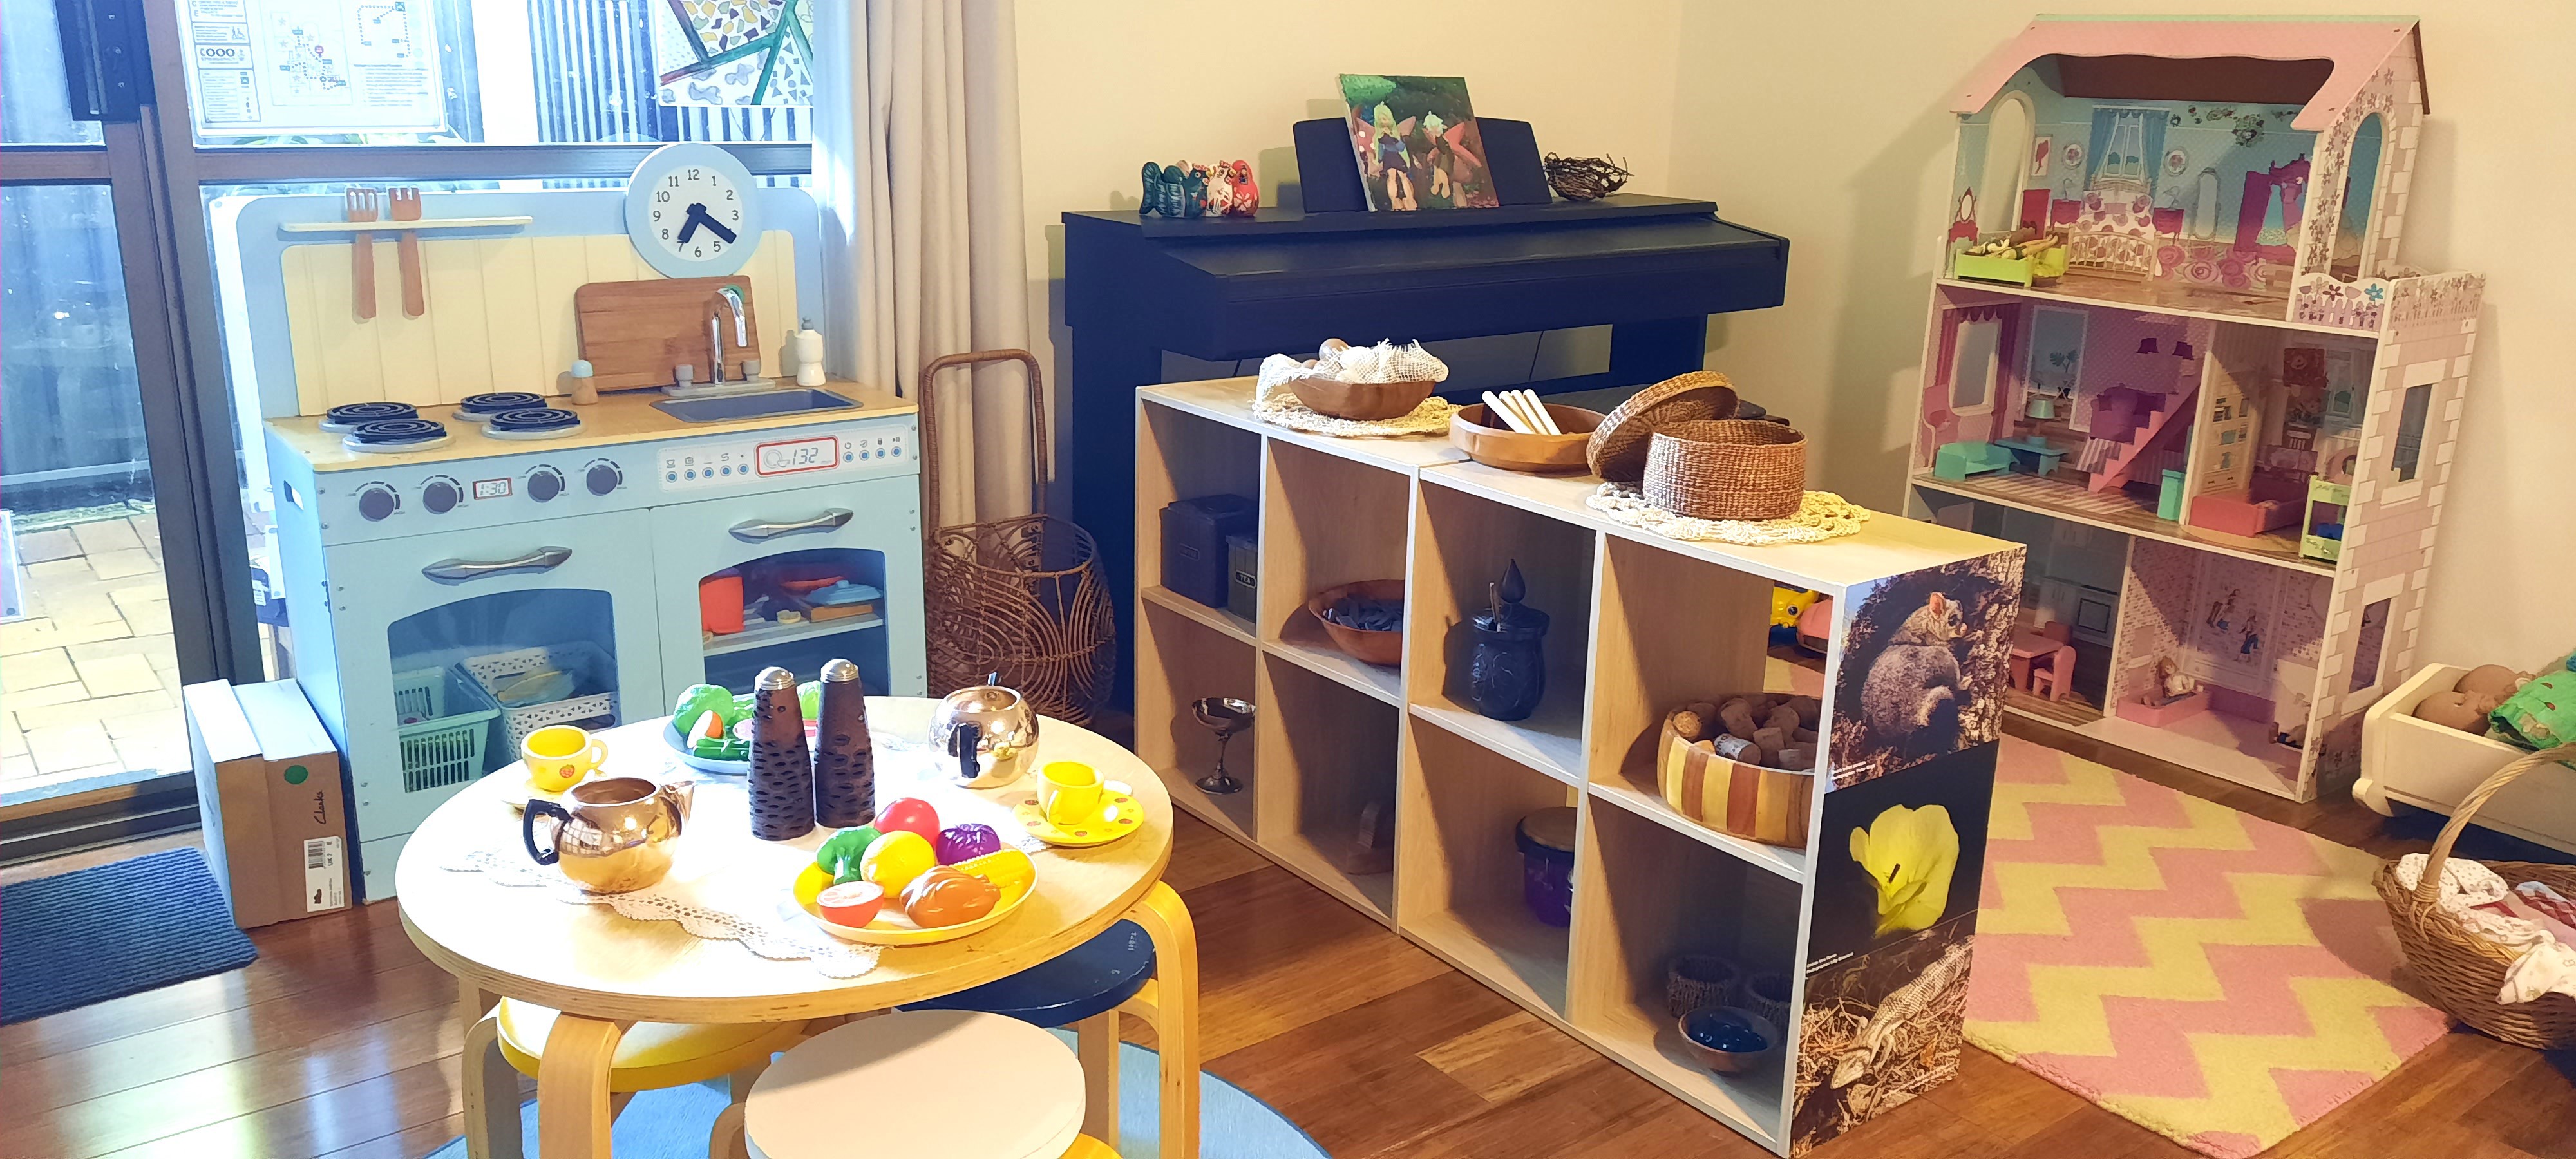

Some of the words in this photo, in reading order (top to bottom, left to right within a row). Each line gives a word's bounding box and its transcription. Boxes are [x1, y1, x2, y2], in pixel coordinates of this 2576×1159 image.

[687, 169, 700, 180] 12
[668, 176, 679, 187] 11
[712, 176, 717, 187] 1
[656, 191, 670, 203] 10
[726, 189, 734, 201] 2
[653, 211, 661, 222] 9
[732, 209, 739, 221] 3
[661, 229, 669, 240] 8
[677, 241, 685, 252] 7
[694, 246, 702, 258] 6
[713, 241, 721, 252] 5
[792, 448, 819, 466] 132
[480, 482, 506, 495] 1:30
[1240, 574, 1251, 584] TEA
[314, 789, 326, 824] Clarks
